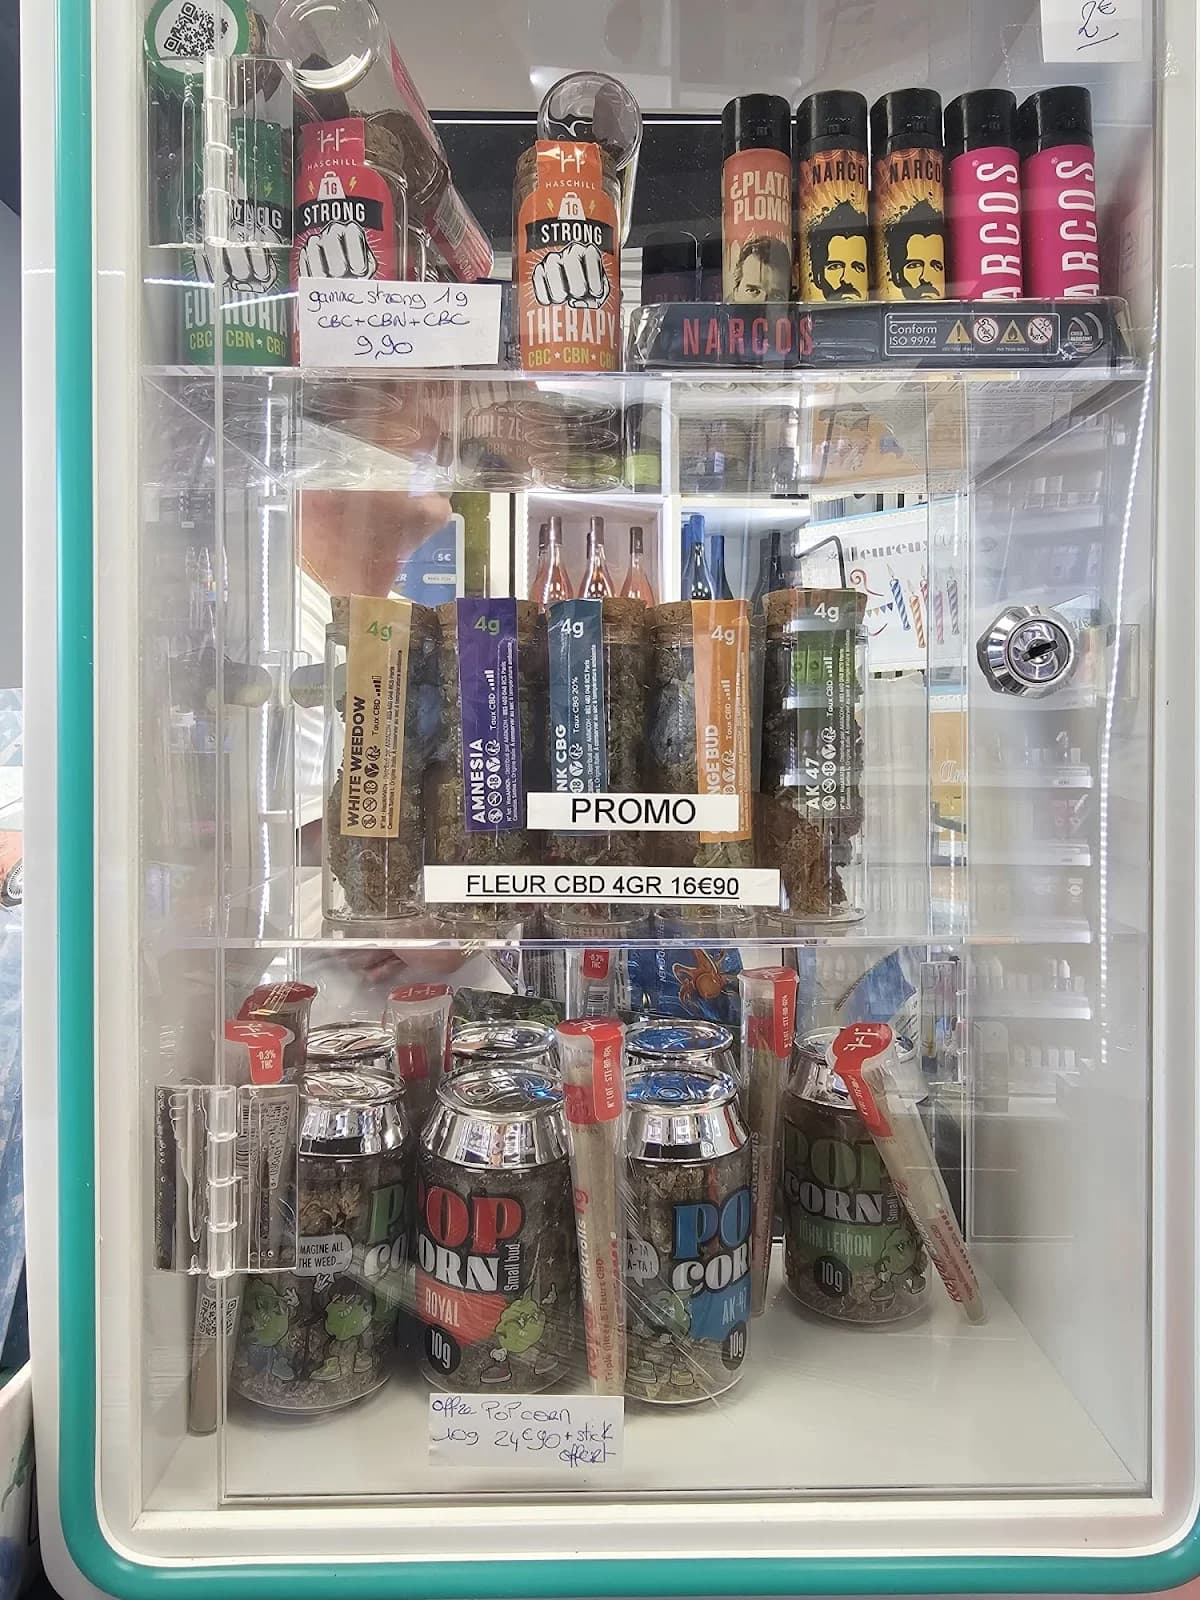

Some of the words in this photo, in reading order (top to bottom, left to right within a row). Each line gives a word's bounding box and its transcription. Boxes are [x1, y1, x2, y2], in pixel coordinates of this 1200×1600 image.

[307, 159, 357, 171] HASCHILL
[324, 181, 338, 194] 1G
[545, 180, 596, 190] HASCHILL
[303, 201, 366, 226] STRONG
[565, 201, 579, 216] 1G
[541, 222, 602, 245] STRONG
[367, 283, 427, 309] strong
[526, 305, 616, 348] THERAPY
[683, 318, 815, 356] NARCOS
[889, 324, 937, 335] Conform
[190, 331, 213, 350] CBC
[226, 330, 255, 349] CBN
[354, 334, 413, 360] 9,90
[889, 336, 907, 345] ISO
[910, 336, 937, 345] 9994
[528, 348, 551, 368] CBC
[563, 346, 590, 366] CBN
[814, 602, 840, 622] 4g
[366, 619, 393, 641] 4g
[473, 615, 501, 637] 4g
[560, 619, 585, 638] 4g
[710, 624, 736, 646] 4g
[571, 676, 579, 695] 20%
[372, 699, 381, 716] CBD
[488, 693, 496, 710] CBD
[826, 698, 834, 717] Taux
[371, 716, 380, 736] Taux
[488, 711, 497, 730] Taux
[572, 714, 580, 734] Taux
[350, 695, 366, 772] WEEDOW
[555, 724, 567, 763] CBG
[705, 725, 719, 759] BUD
[706, 762, 720, 794] NGE
[805, 757, 819, 779] 47
[469, 739, 486, 824] AMNESIA
[347, 776, 362, 827] WHITE
[806, 784, 820, 810] AK
[571, 797, 696, 825] PROMO
[467, 874, 548, 894] FLEUR
[553, 874, 605, 894] CBD
[612, 875, 662, 895] 4GR
[673, 876, 739, 896] 16€90
[419, 1185, 522, 1253] OP
[331, 1242, 344, 1252] ALL
[576, 1218, 593, 1303] Stickrolls
[503, 1263, 520, 1291] Small
[821, 1261, 842, 1293] 10g
[425, 1288, 460, 1328] ROYAL
[431, 1330, 451, 1369] 10g
[729, 1333, 744, 1360] 10g
[577, 1420, 614, 1443] stick
